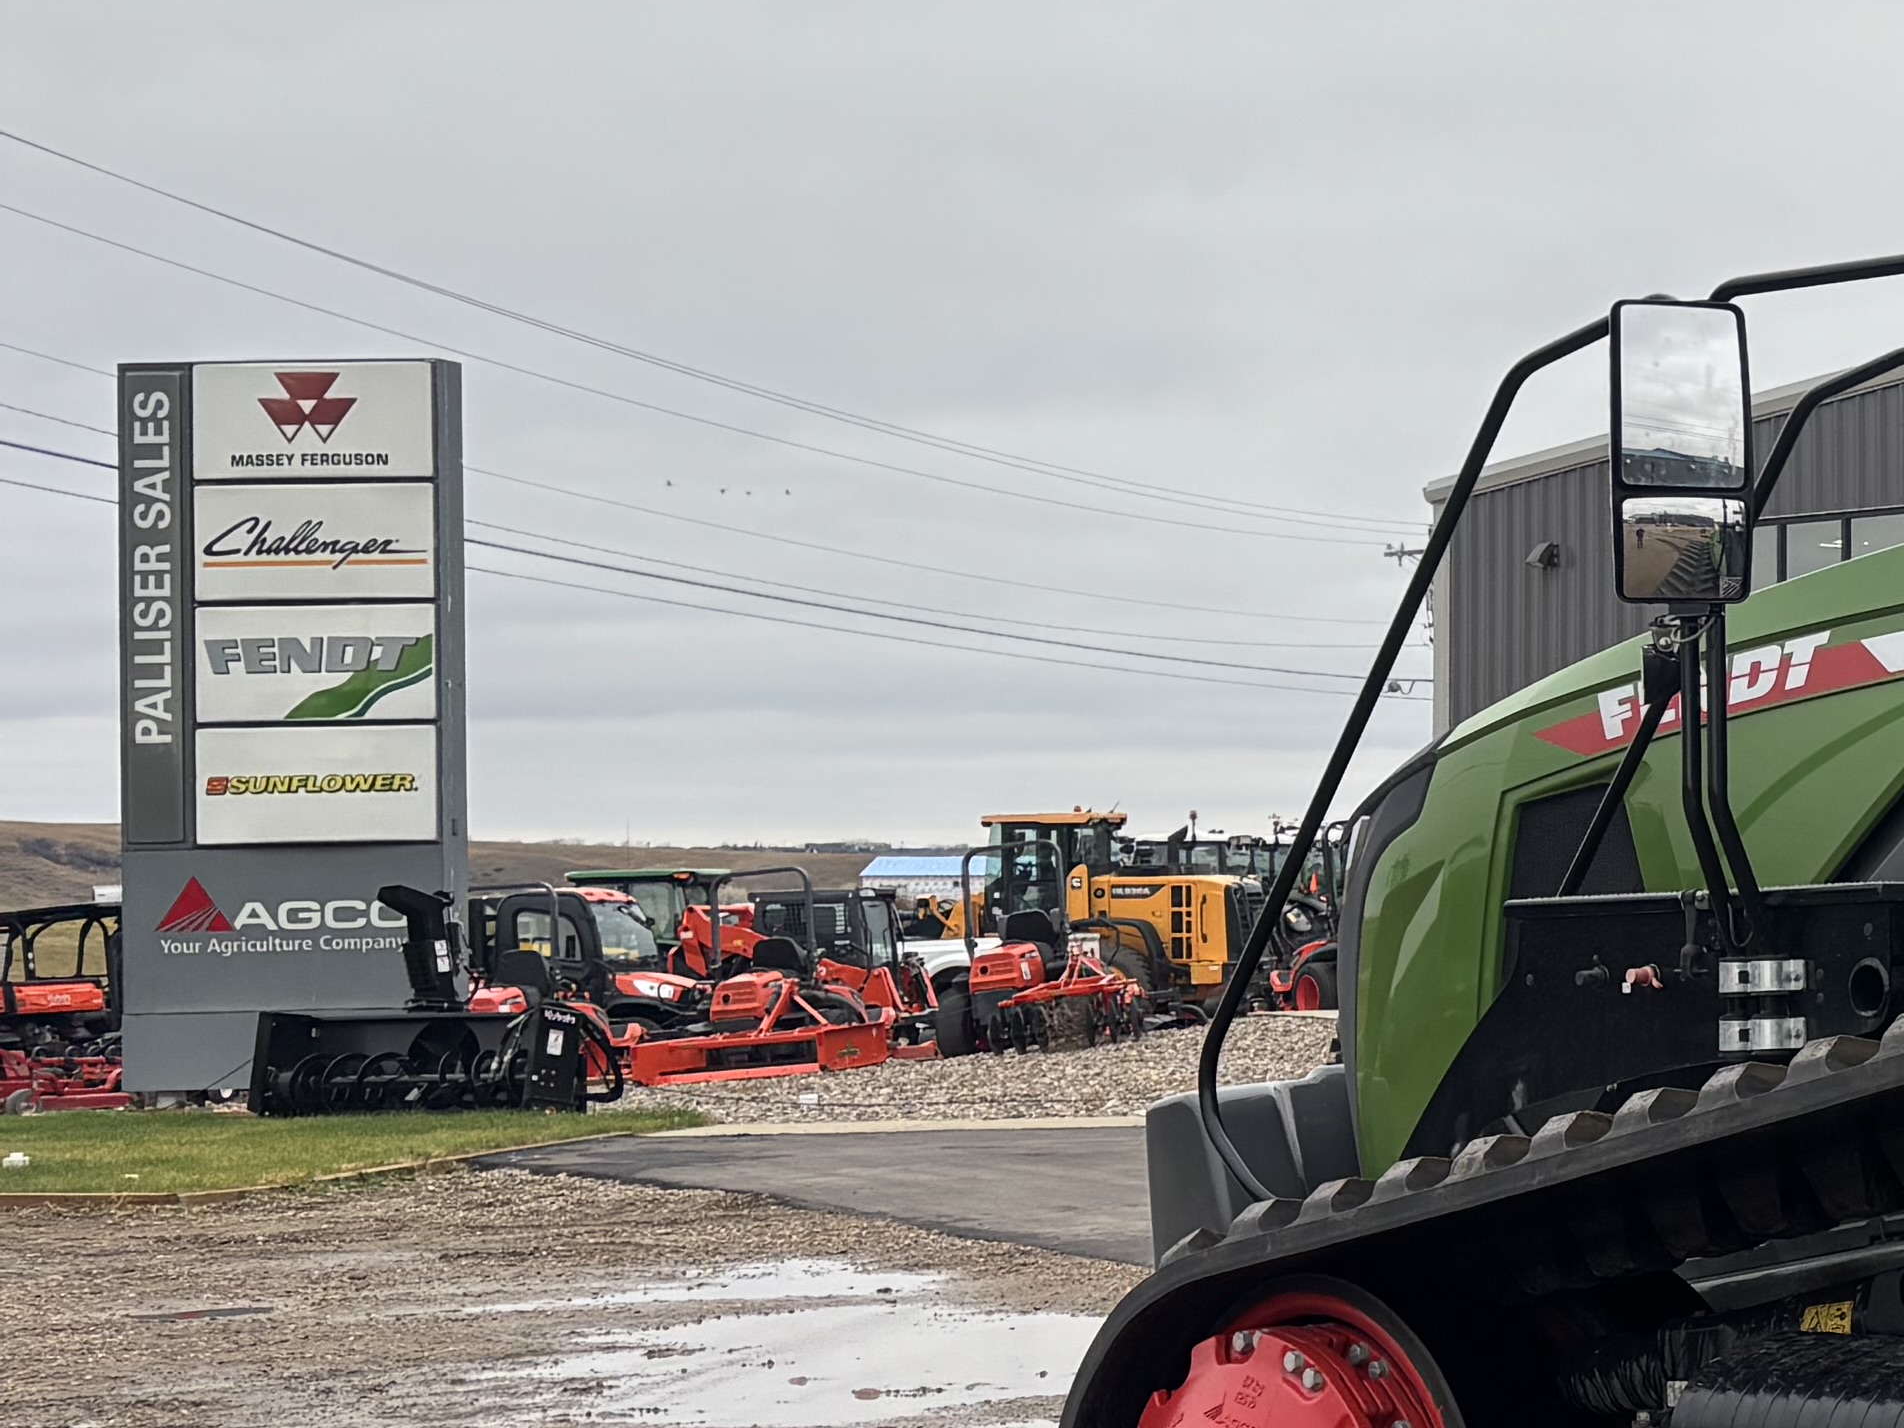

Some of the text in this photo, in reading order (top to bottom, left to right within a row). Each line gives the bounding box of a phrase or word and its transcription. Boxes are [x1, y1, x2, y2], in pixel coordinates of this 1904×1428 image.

[230, 453, 389, 467] MASSEY FERGUSON
[203, 516, 428, 570] Challenger
[133, 391, 172, 744] PALLISER SALES
[203, 635, 422, 675] FENDT
[160, 935, 408, 957] Your Agriculture Company
